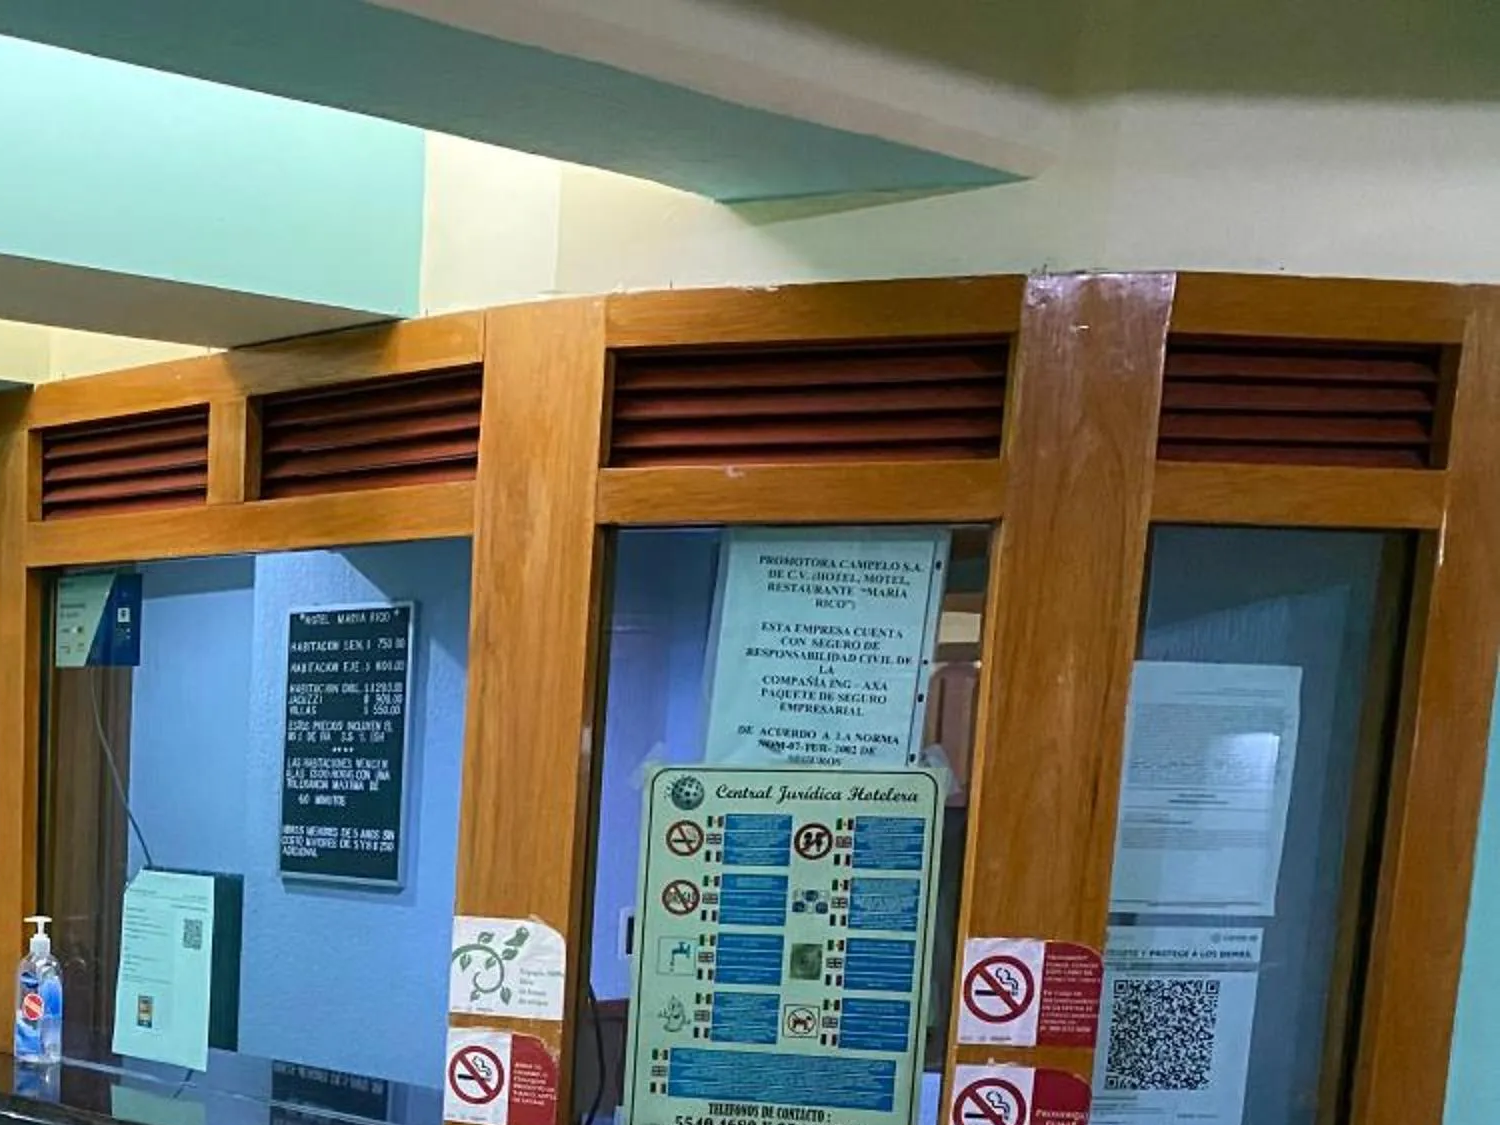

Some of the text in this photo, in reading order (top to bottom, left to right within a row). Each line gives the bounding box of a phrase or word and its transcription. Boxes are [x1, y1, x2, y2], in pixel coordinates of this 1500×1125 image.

[759, 555, 836, 568] PROMOTORA
[839, 559, 899, 572] CAMPELO
[768, 569, 786, 579] DE
[767, 582, 853, 596] RESTAURANTE
[761, 621, 903, 639] ESTA EMPRESA CUENTA
[780, 636, 881, 650] CON SEGURO DE
[745, 647, 913, 665] RESPONSABILIDAD CIVIL DE
[819, 665, 835, 674] LA
[761, 688, 887, 705] PAQUETE DE SEGURO
[779, 702, 864, 717] EMPRESARIAL
[738, 725, 899, 745] DE ACUERDO A LA NORMA
[860, 746, 877, 755] DE
[716, 783, 919, 804] Central Jurídica Hotelera
[761, 1105, 774, 1118] DE
[777, 1106, 825, 1122] CONTACTO
